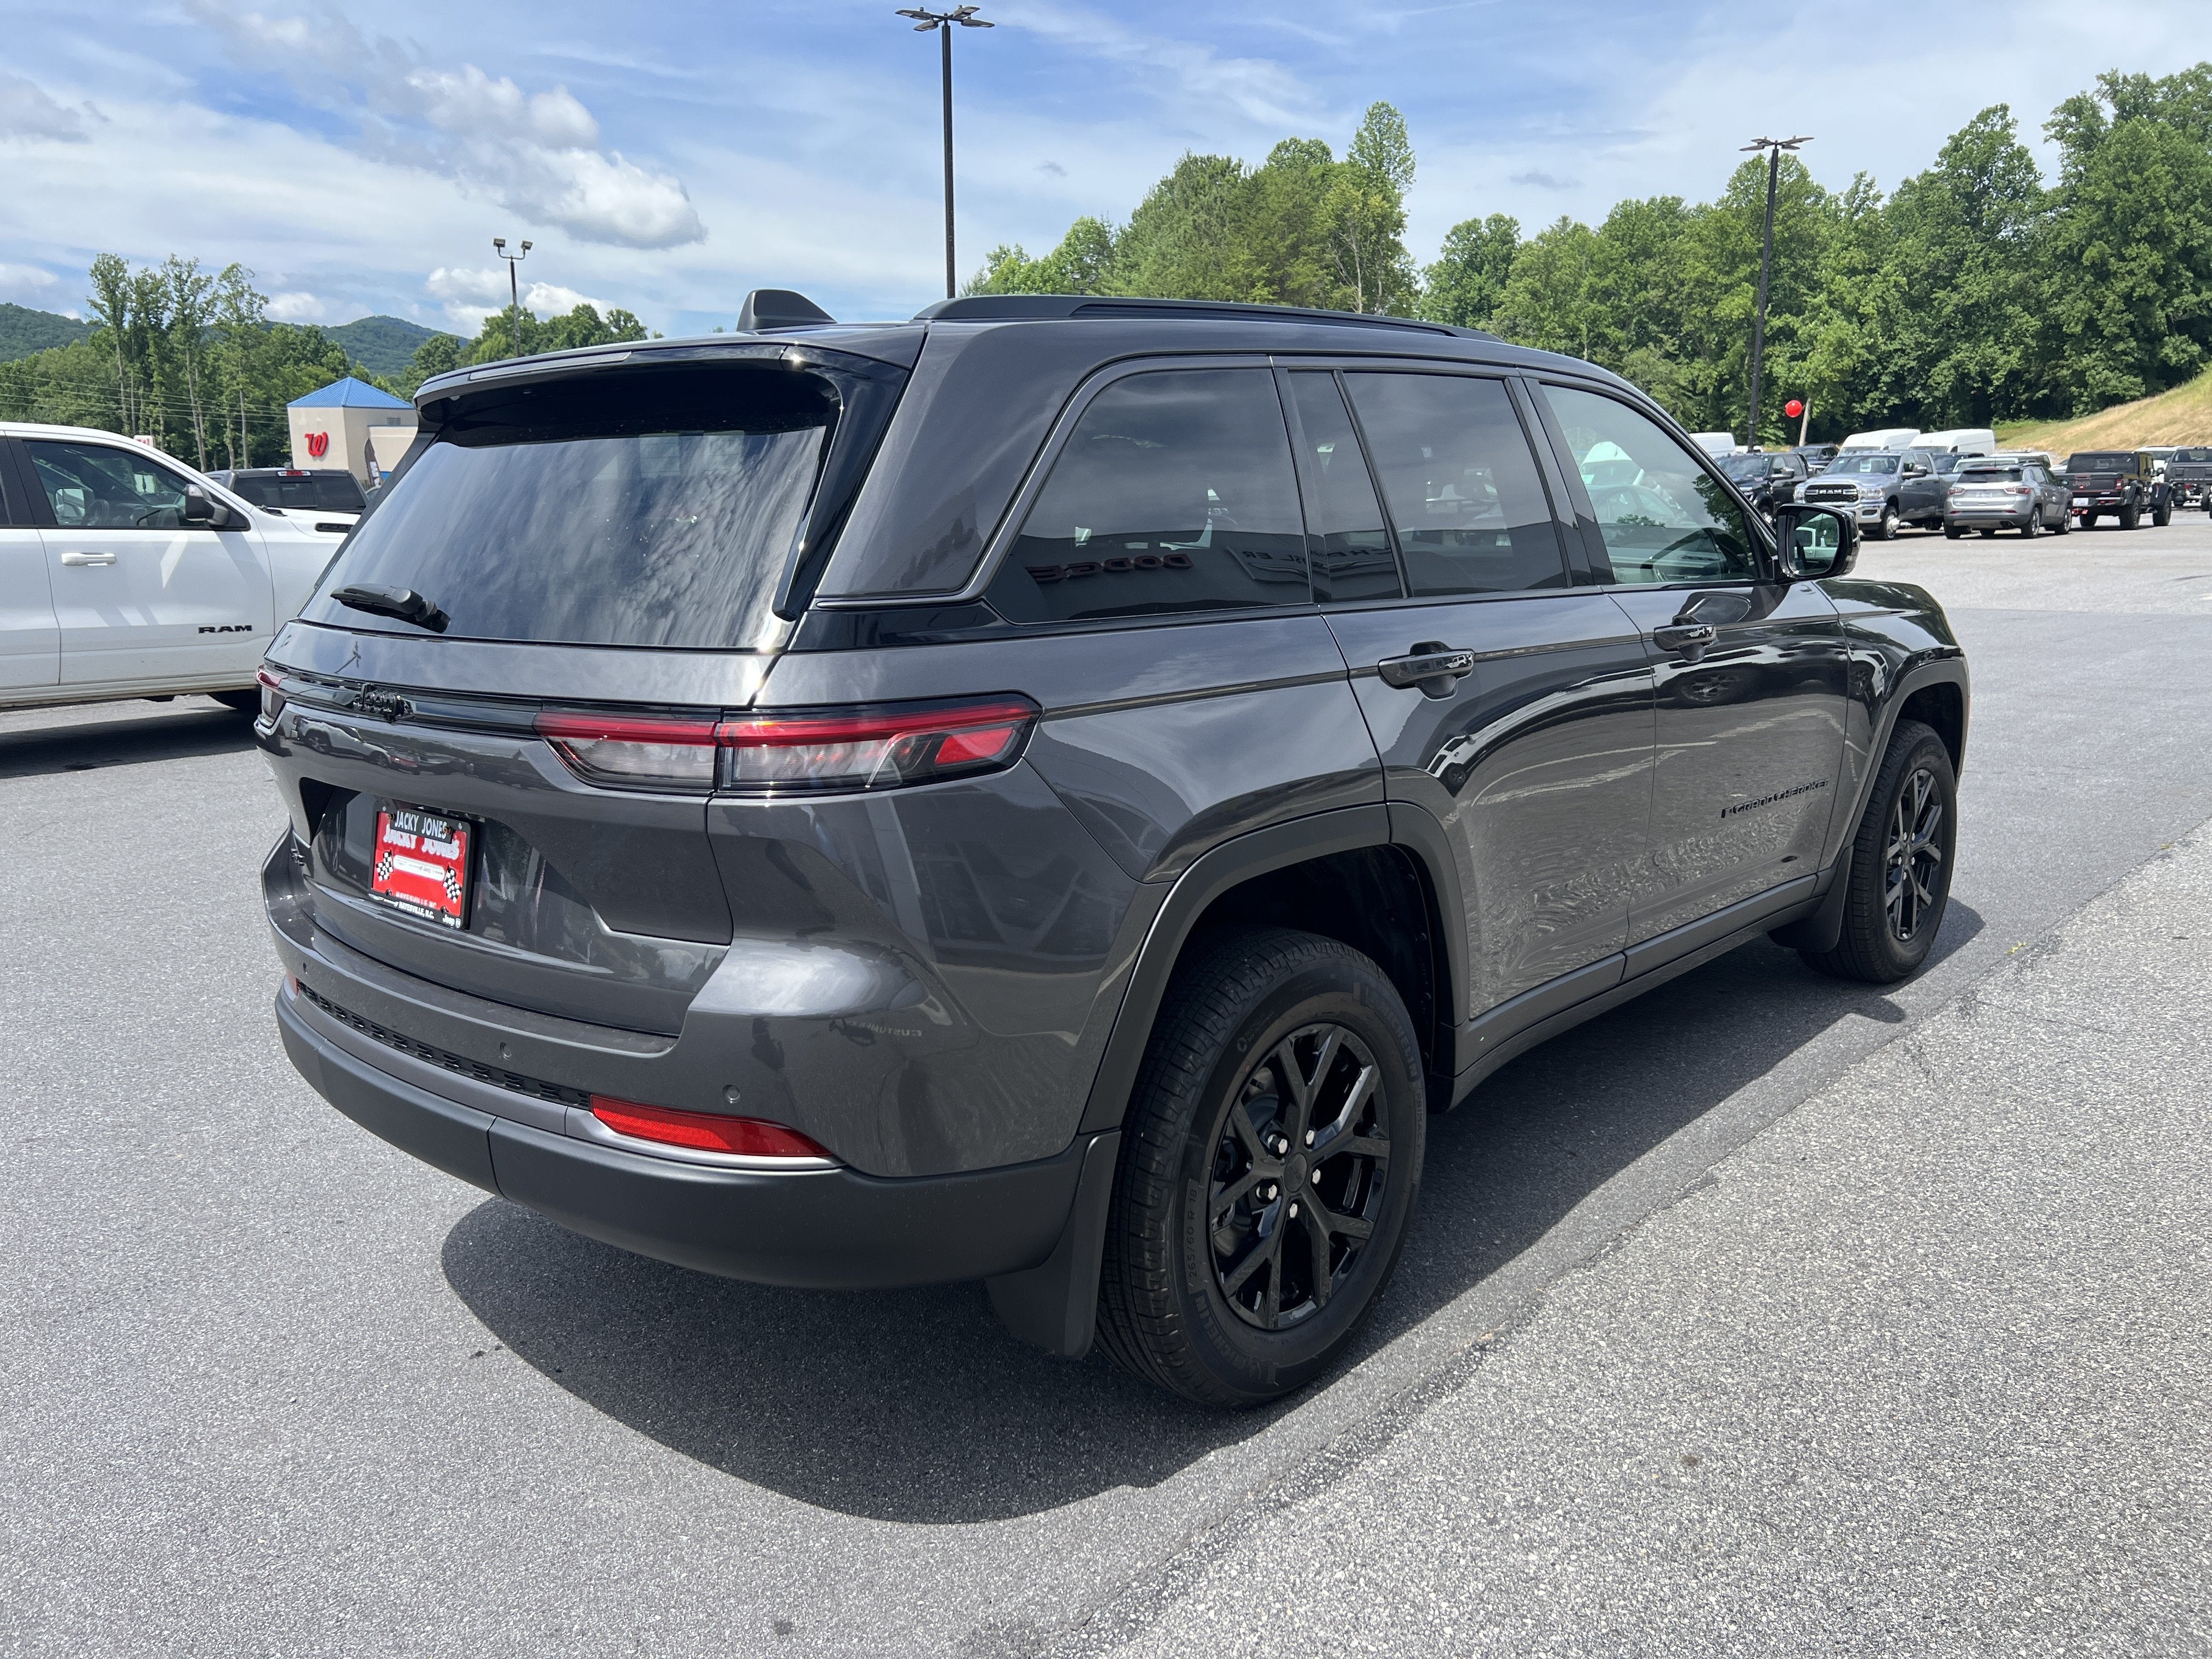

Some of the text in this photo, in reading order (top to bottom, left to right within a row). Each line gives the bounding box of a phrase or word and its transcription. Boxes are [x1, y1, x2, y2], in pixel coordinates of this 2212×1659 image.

[198, 625, 252, 634] RAM
[383, 823, 418, 849] JACKY
[394, 811, 448, 839] JACKY JONES
[442, 914, 455, 927] Jeep
[1187, 1188, 1198, 1278] 265/60 R 18
